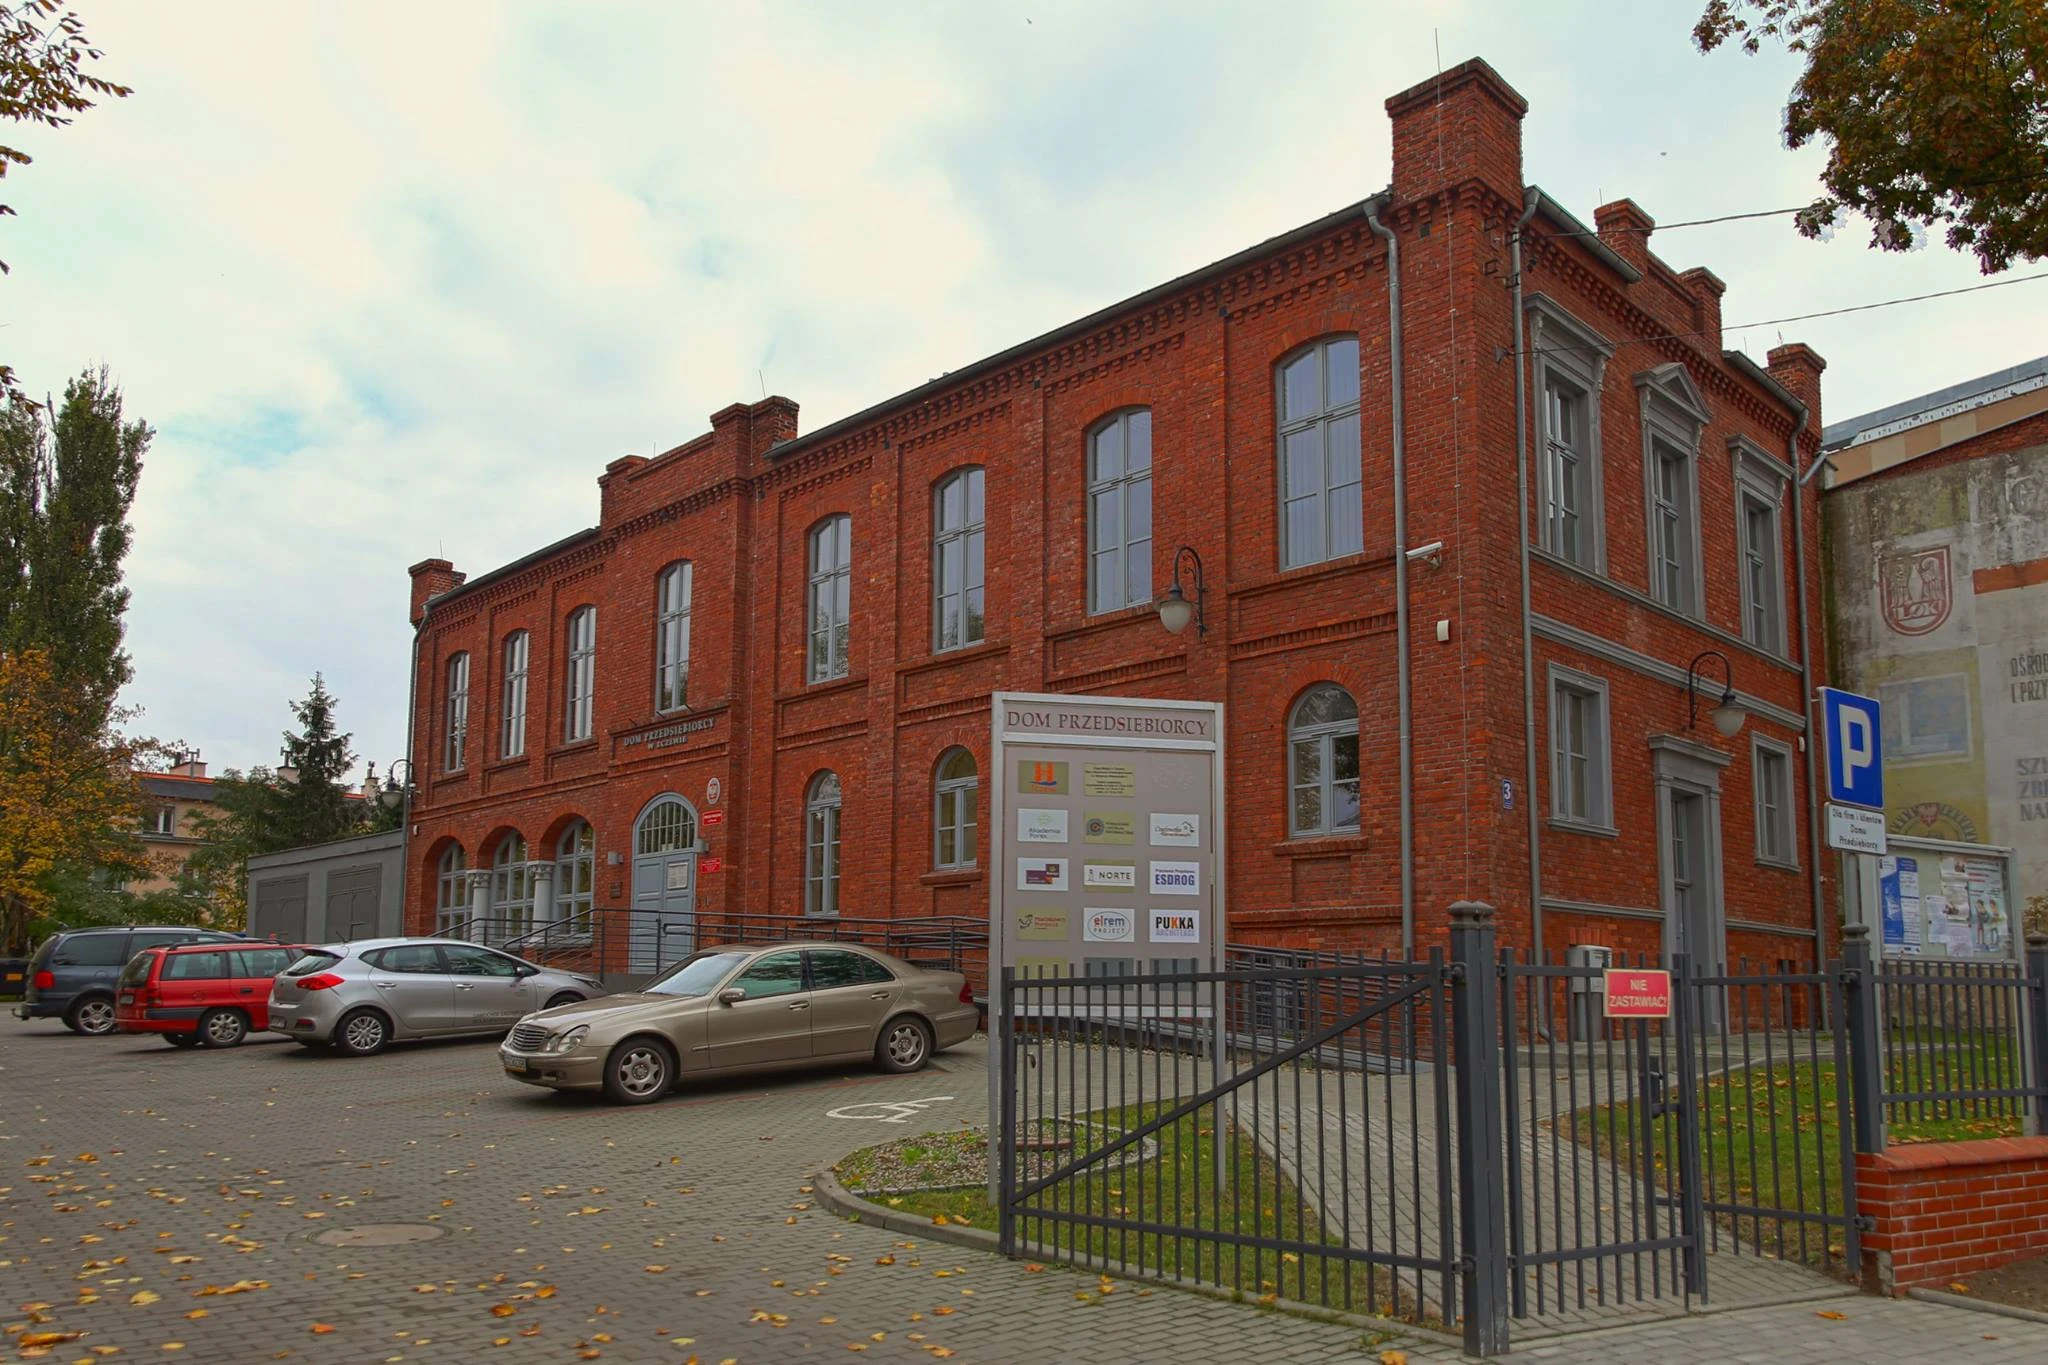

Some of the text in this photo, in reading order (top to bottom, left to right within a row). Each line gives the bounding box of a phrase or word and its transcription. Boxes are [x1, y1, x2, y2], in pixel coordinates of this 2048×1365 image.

[1894, 602, 1938, 620] LOK
[1008, 711, 1052, 728] DOM
[623, 735, 642, 746] DOM
[1838, 704, 1872, 789] P
[1504, 782, 1511, 800] 3
[1098, 871, 1131, 880] NORTE
[1155, 874, 1195, 886] ESDROG
[1155, 916, 1194, 929] PUKKA
[1630, 979, 1648, 991] NIE
[1609, 993, 1667, 1008] ZASTAWIAĆ!
